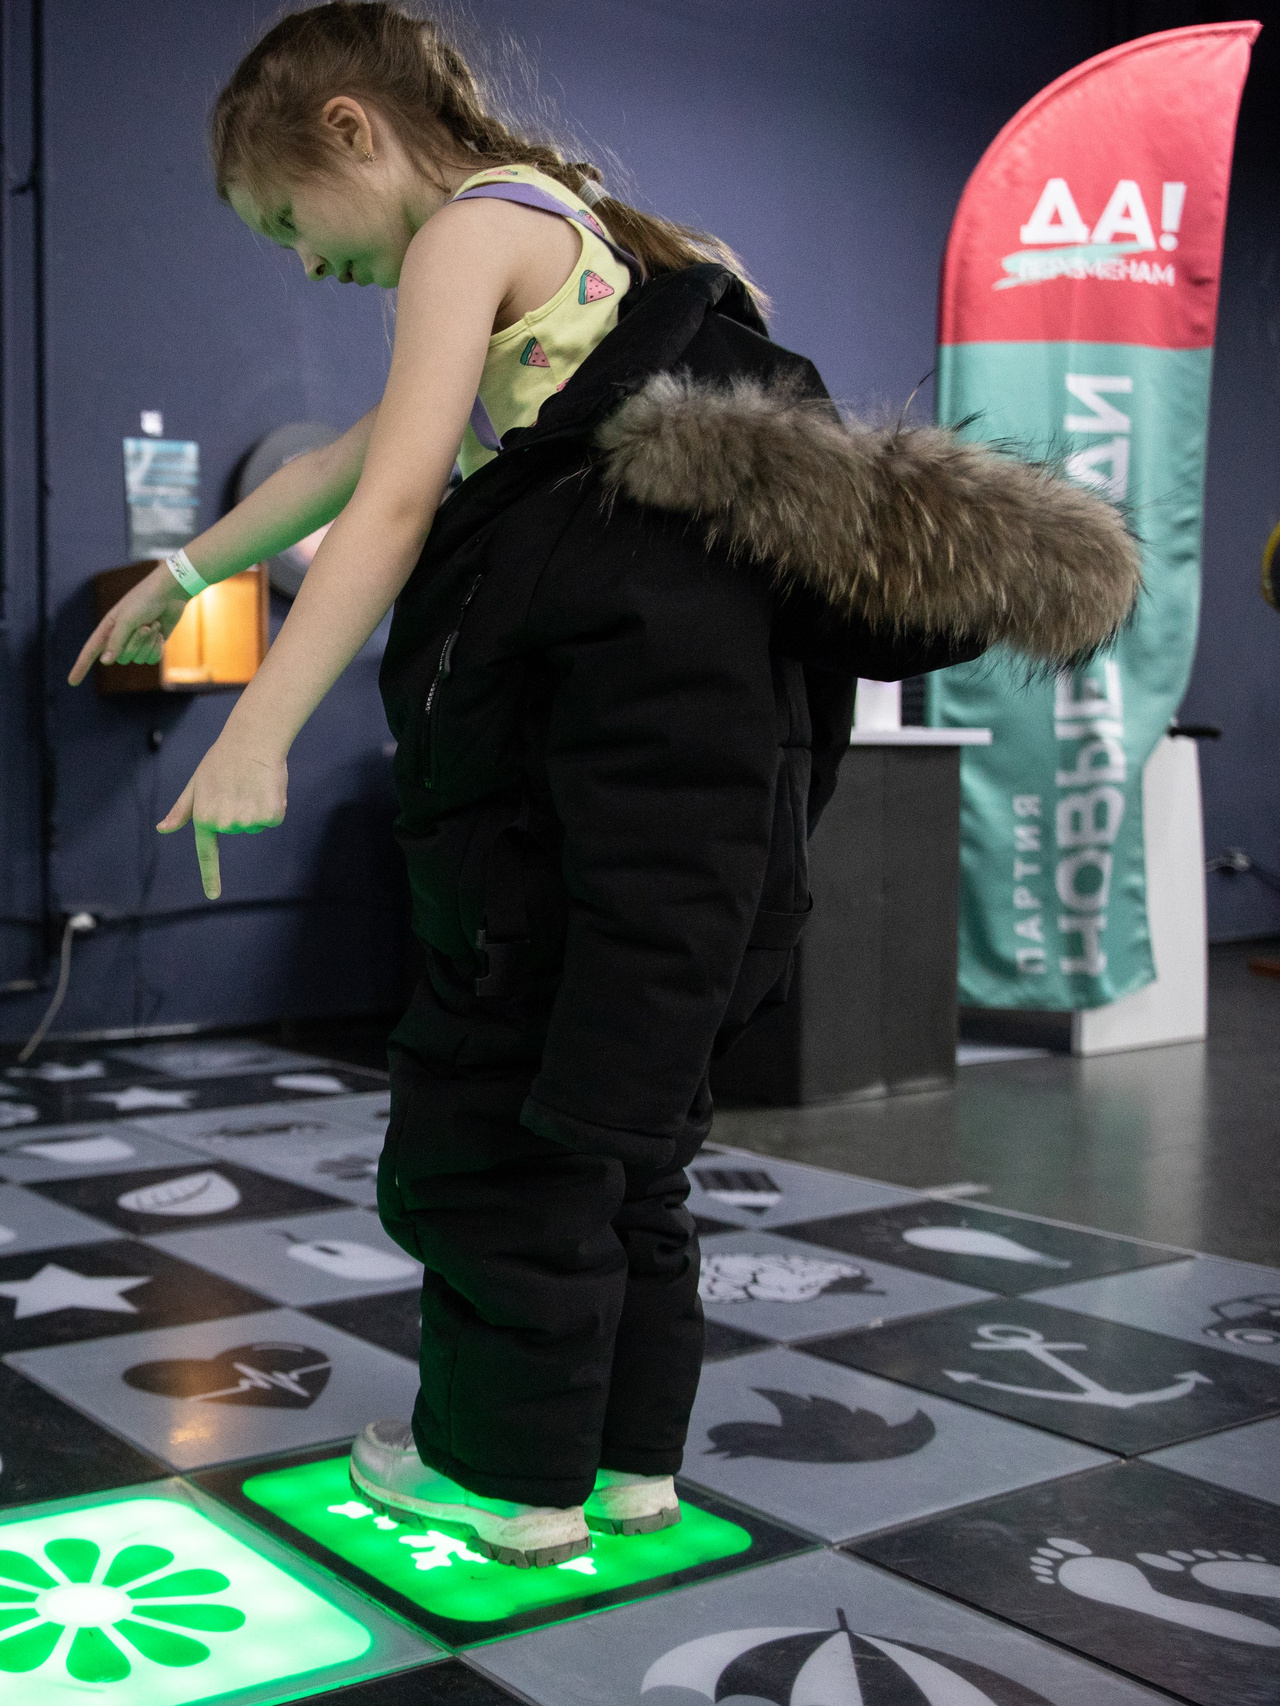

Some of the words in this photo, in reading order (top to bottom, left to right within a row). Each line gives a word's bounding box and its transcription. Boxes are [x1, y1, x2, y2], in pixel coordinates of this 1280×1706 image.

[1020, 178, 1187, 252] ДА!
[1064, 373, 1133, 502] ДИ
[1013, 794, 1047, 975] ПАРТИЯ
[1055, 658, 1125, 976] НОВЫЕ
